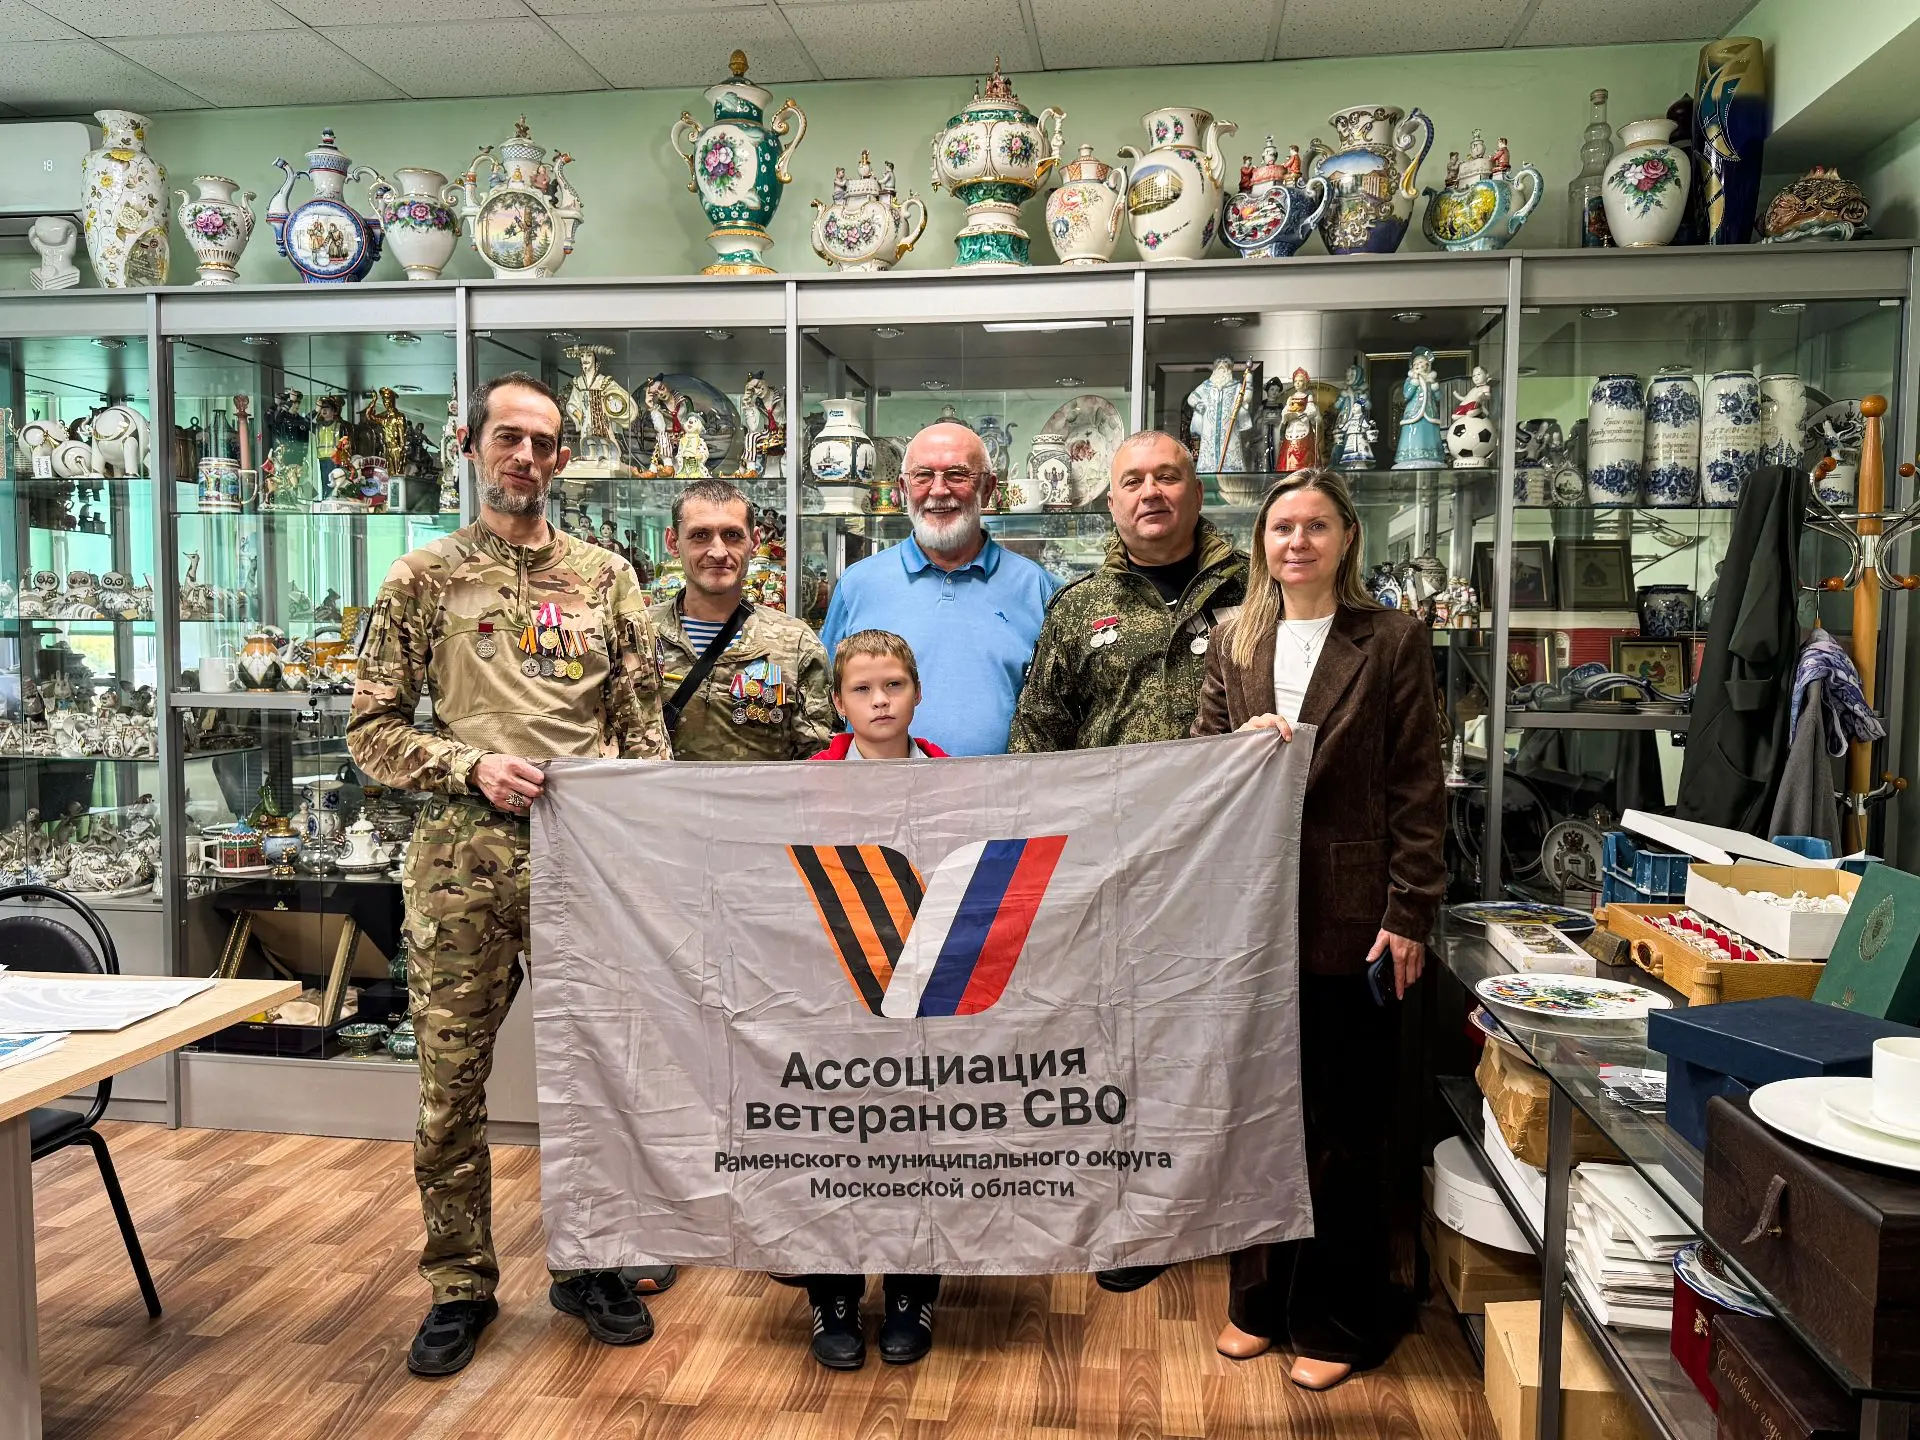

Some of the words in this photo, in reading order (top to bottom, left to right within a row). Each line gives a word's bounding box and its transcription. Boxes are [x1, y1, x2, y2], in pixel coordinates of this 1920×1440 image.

[43, 160, 53, 171] 18
[780, 1047, 1086, 1092] Ассоциация
[746, 1102, 1008, 1143] ветеранов
[1023, 1084, 1127, 1128] СВО
[714, 1151, 862, 1173] Раменского
[868, 1150, 1080, 1174] муниципального
[1086, 1150, 1172, 1173] округа
[810, 1177, 964, 1198] Московской
[971, 1179, 1075, 1199] области
[1727, 1369, 1760, 1414] новым
